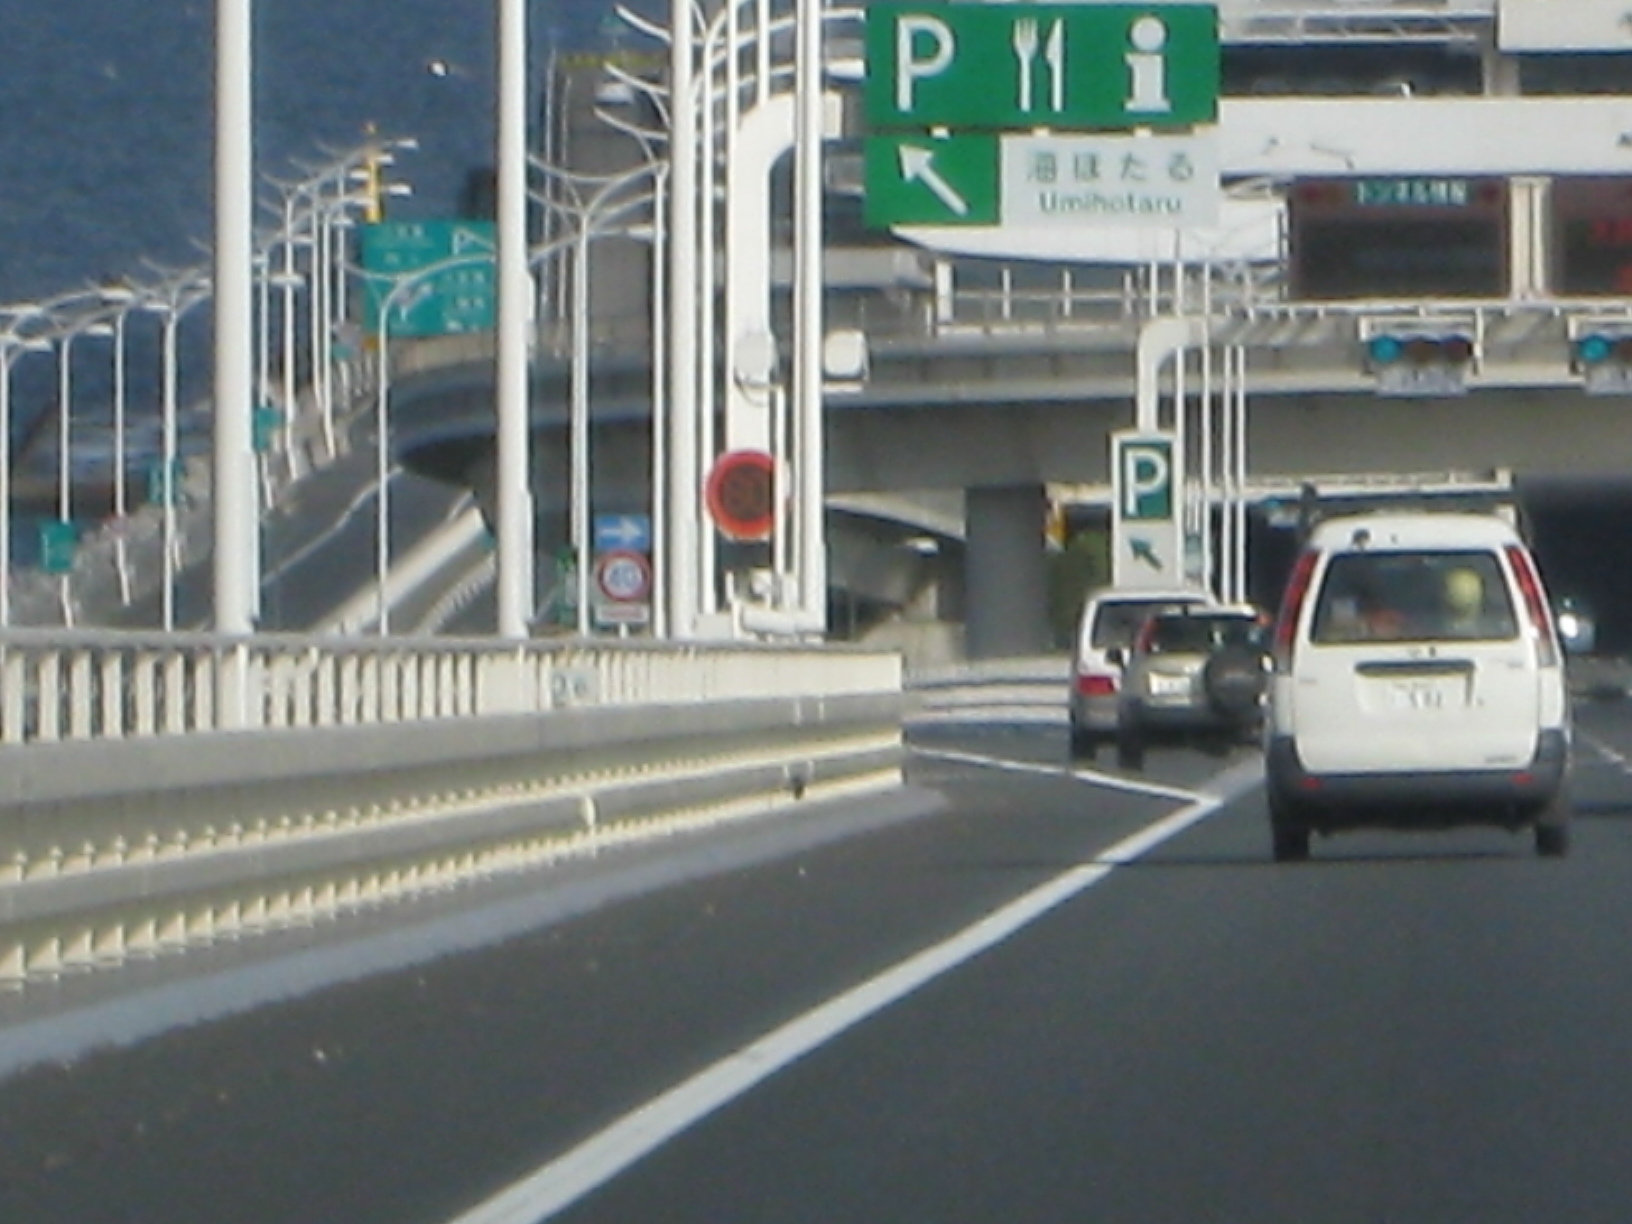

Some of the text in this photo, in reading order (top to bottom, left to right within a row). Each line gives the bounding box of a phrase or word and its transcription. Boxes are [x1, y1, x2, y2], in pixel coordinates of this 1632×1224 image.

[898, 15, 955, 112] P
[1026, 150, 1195, 182] 海ほたる
[1038, 191, 1182, 212] Umihotaru
[1126, 447, 1168, 515] P
